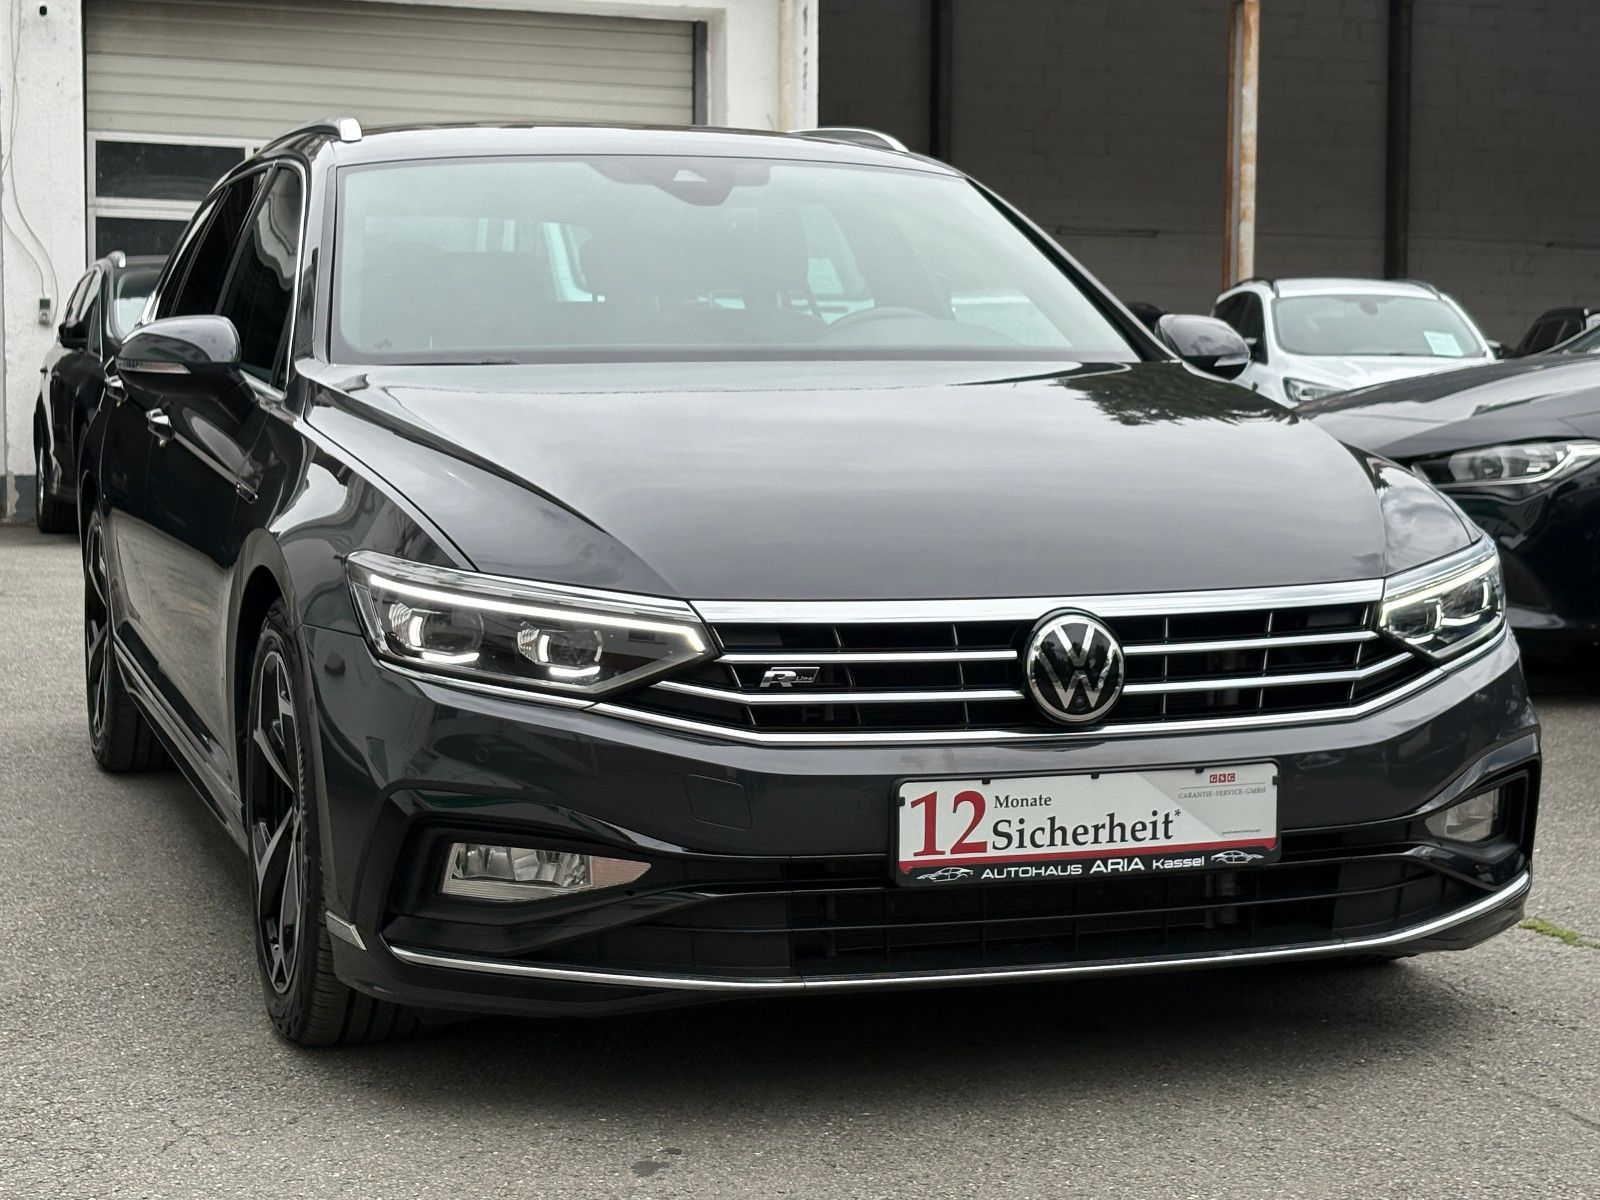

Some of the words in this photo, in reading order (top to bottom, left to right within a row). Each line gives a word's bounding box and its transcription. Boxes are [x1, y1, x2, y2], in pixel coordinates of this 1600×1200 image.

[1029, 617, 1121, 712] VW
[760, 670, 797, 688] R
[993, 794, 1052, 809] Monate
[910, 790, 988, 857] 12
[980, 864, 1083, 879] AUTOHAUS
[1089, 857, 1146, 874] ARIA
[1151, 855, 1205, 870] Kassel
